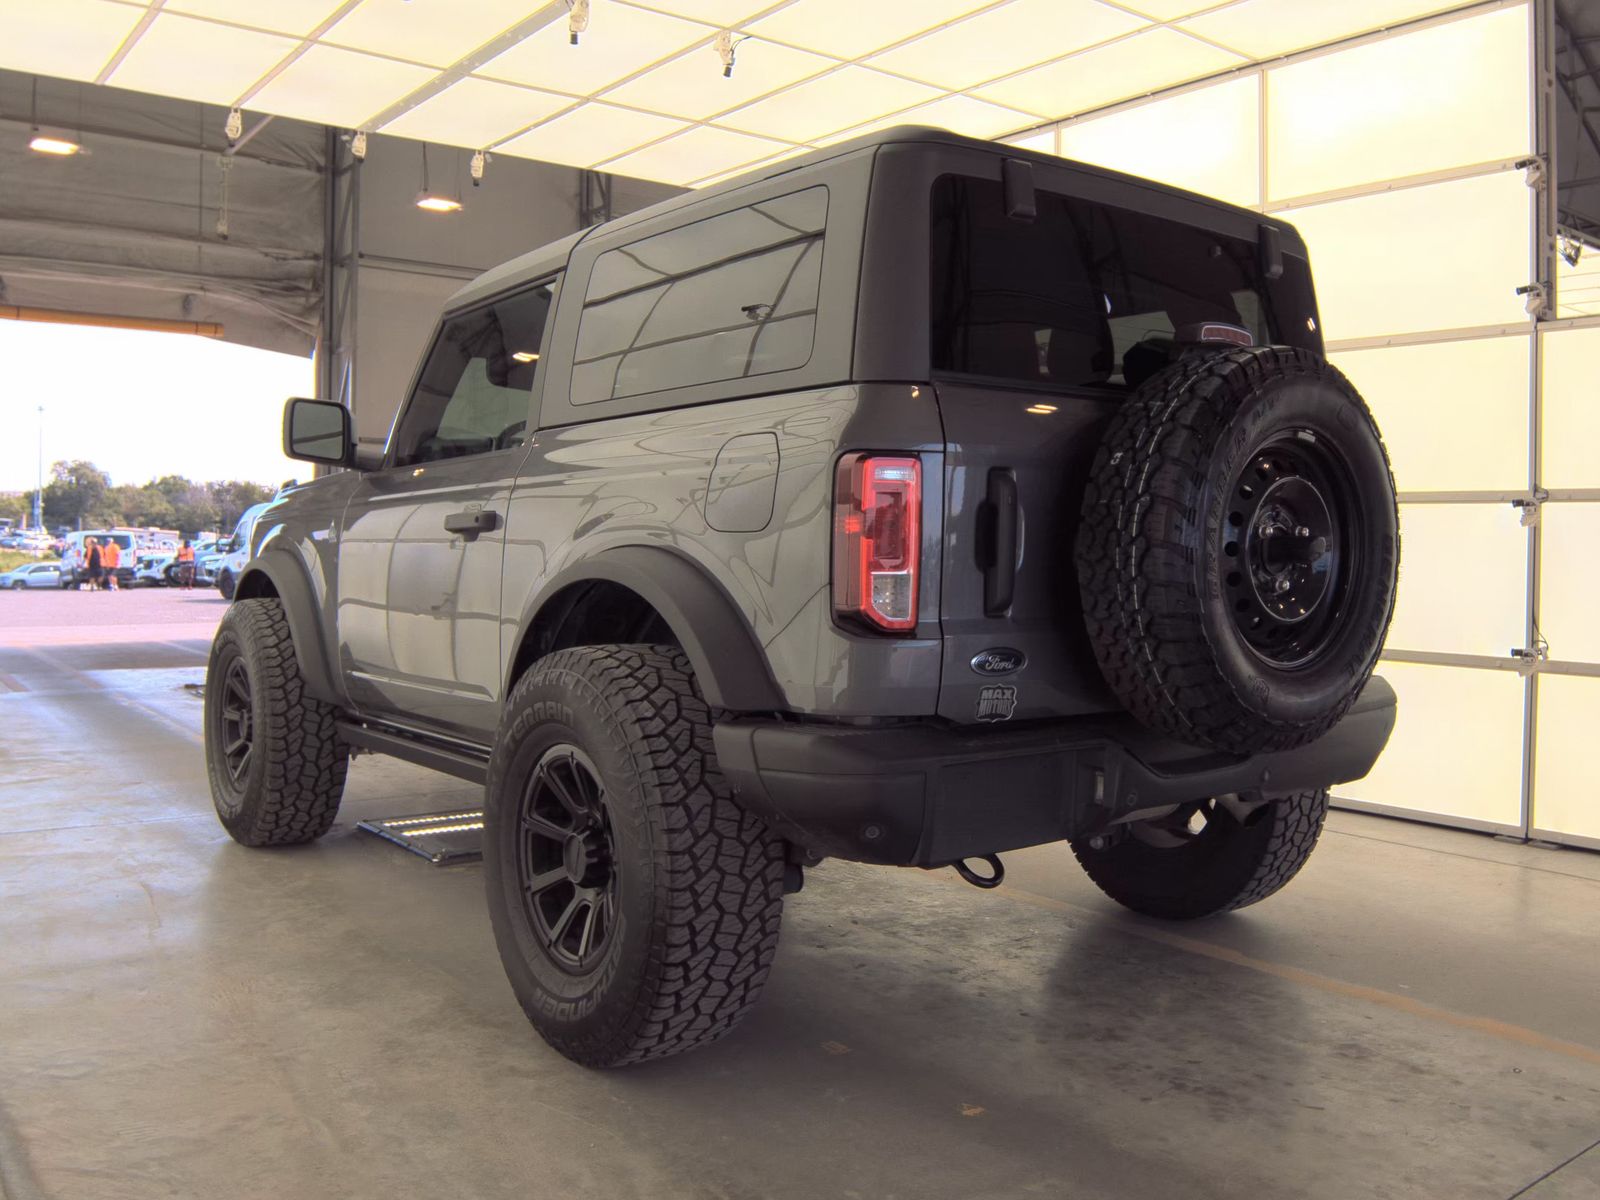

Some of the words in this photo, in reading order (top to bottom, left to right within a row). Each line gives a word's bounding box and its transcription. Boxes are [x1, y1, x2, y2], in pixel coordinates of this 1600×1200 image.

[985, 655, 1015, 670] Ford
[981, 689, 1013, 699] MAX
[977, 699, 1013, 717] MOTORS
[503, 701, 574, 748] TERRAIN
